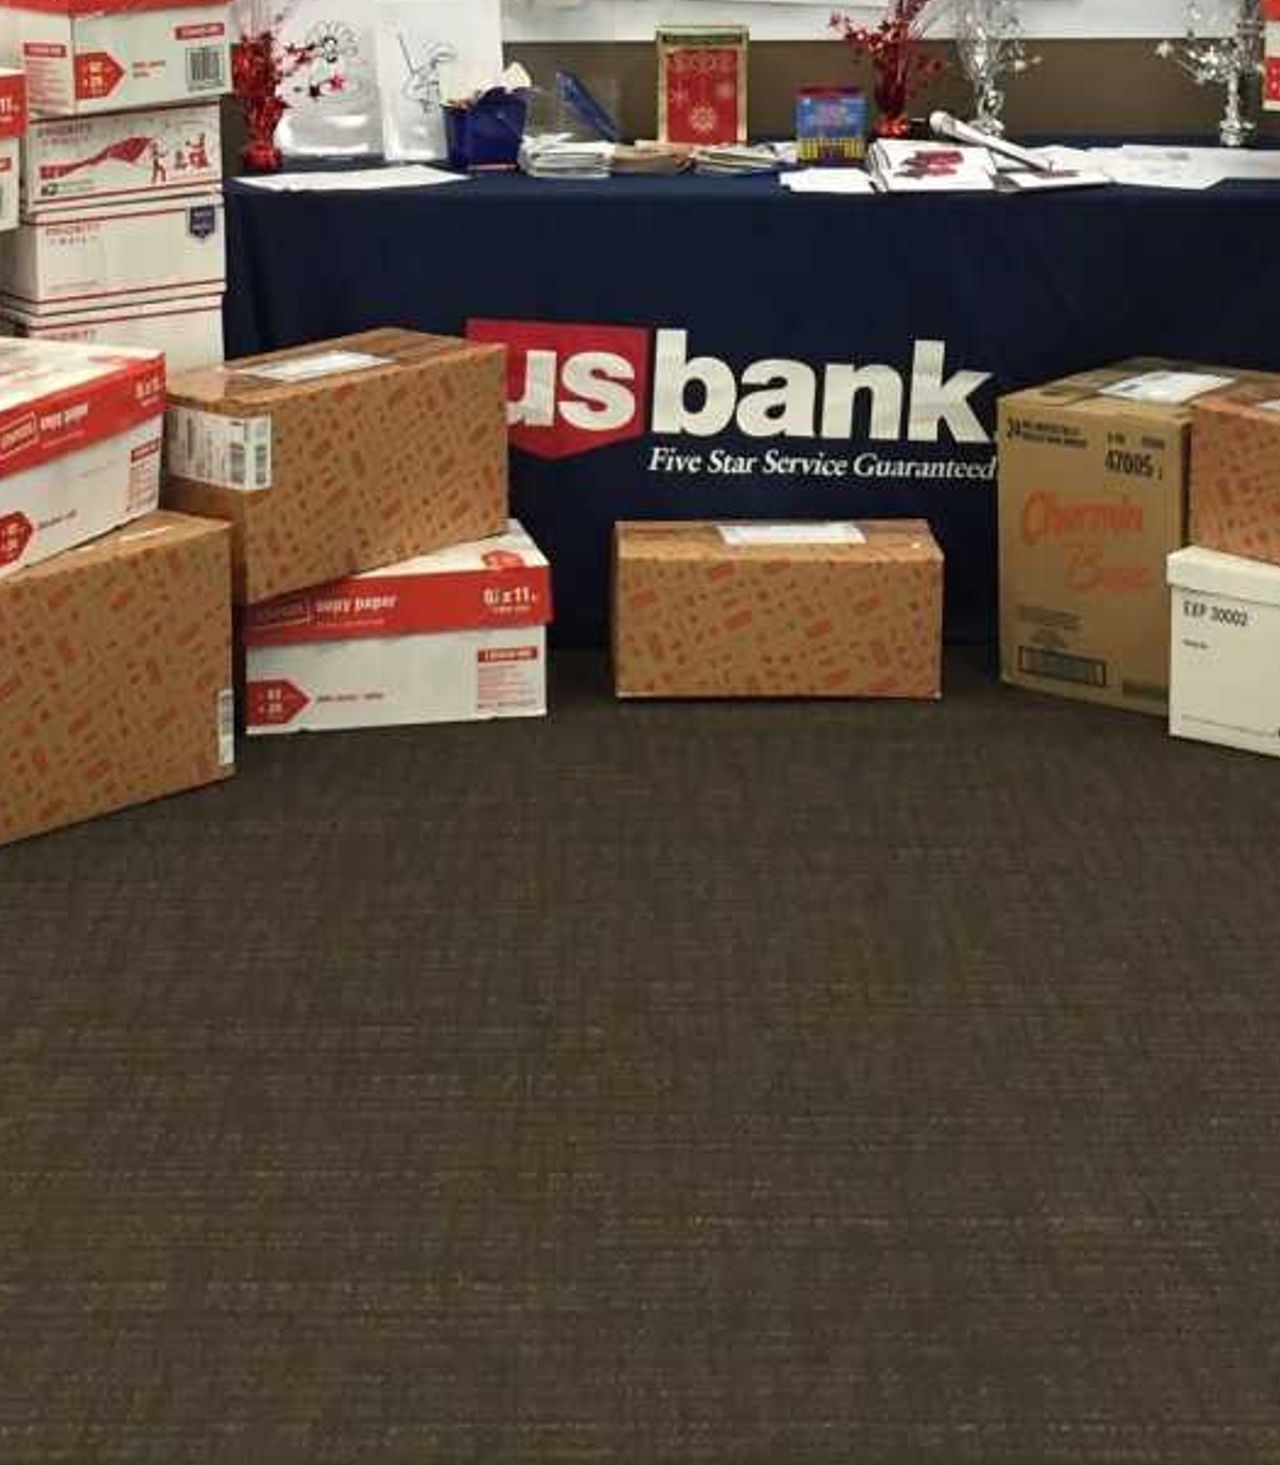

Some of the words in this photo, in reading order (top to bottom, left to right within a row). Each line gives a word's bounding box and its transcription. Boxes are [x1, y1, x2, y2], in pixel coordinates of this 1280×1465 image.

[651, 327, 991, 442] bank
[648, 446, 702, 472] Five
[706, 449, 757, 474] Star
[762, 449, 848, 477] Service
[852, 452, 998, 481] Guaranteed
[354, 595, 398, 612] paper
[1183, 600, 1207, 618] EXP
